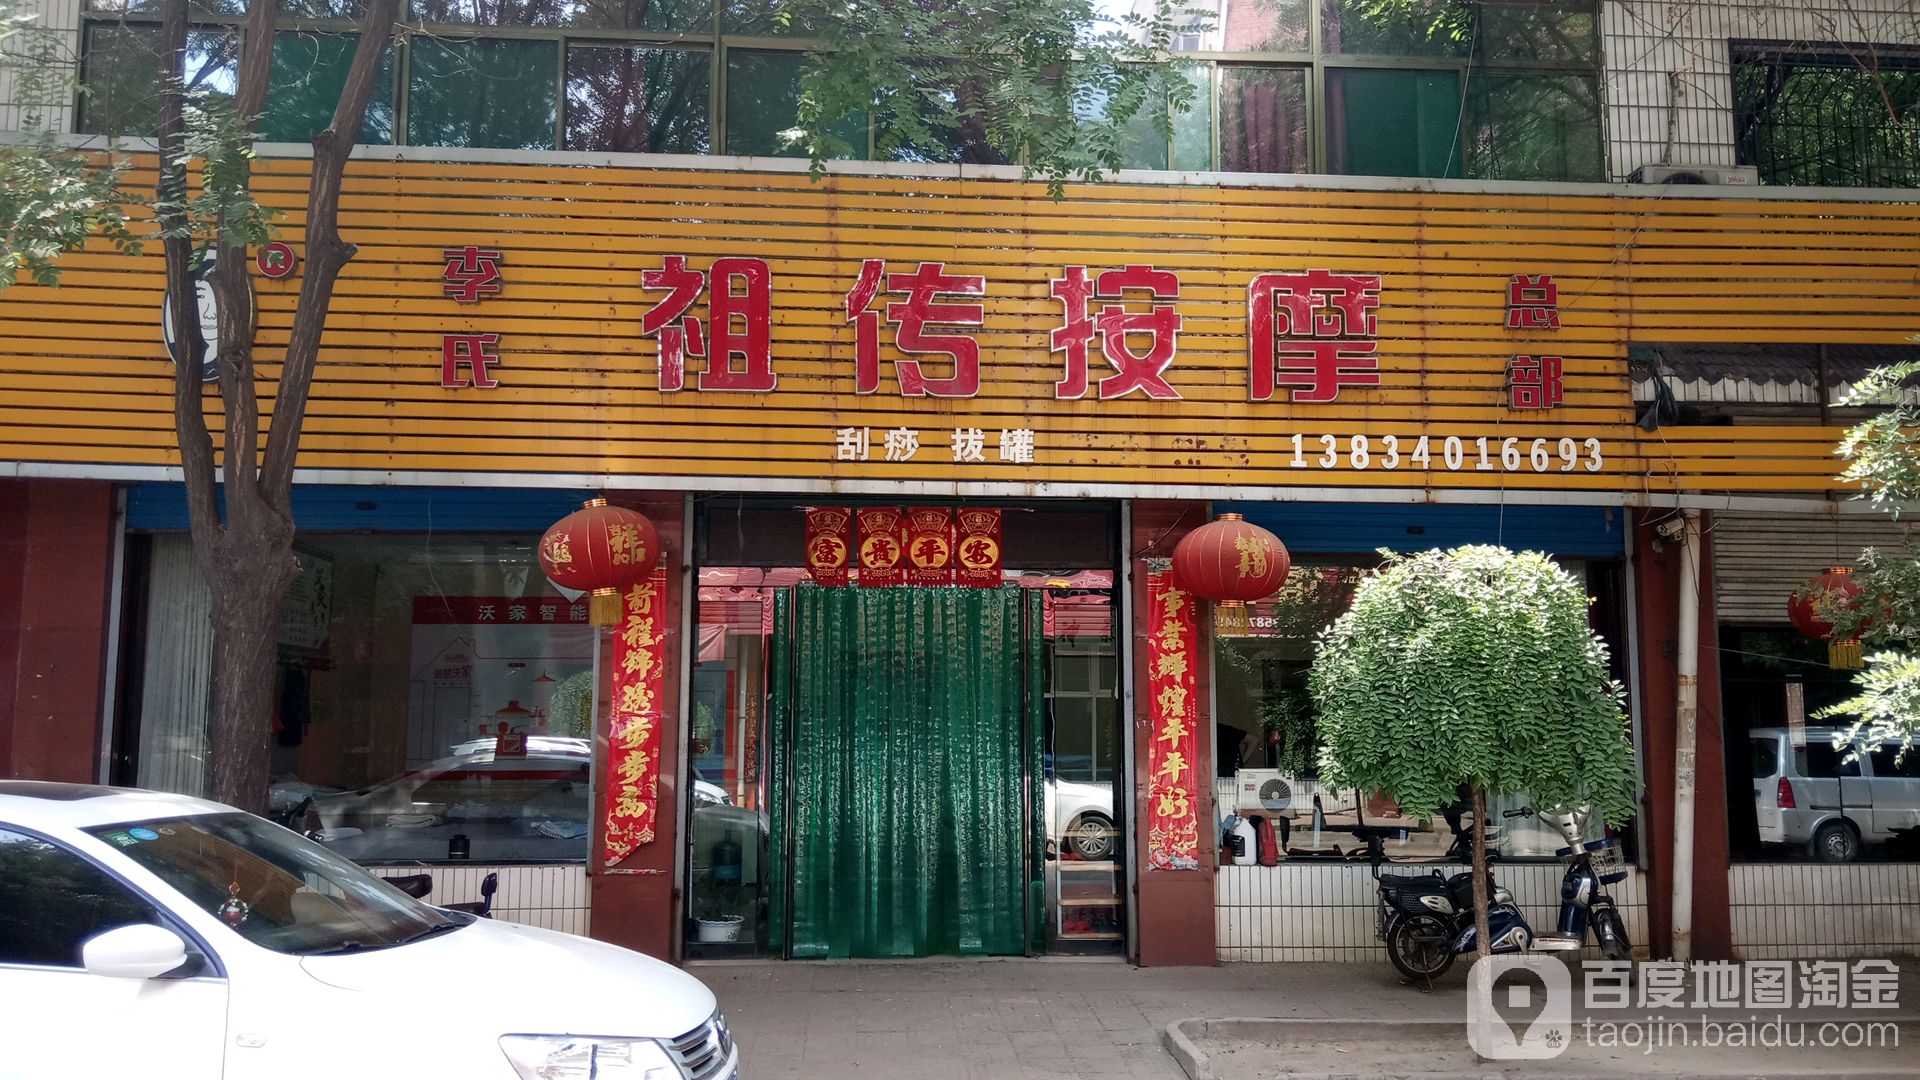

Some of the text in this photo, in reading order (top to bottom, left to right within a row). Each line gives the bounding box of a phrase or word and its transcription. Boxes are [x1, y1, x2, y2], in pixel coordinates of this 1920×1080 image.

[441, 246, 500, 389] 李氏
[641, 254, 1383, 402] 祖传按摩
[1508, 274, 1564, 409] 总部
[836, 427, 1036, 463] 刮痧 拔罐
[1290, 433, 1604, 473] 13834016693
[478, 604, 587, 621] 沃家智能
